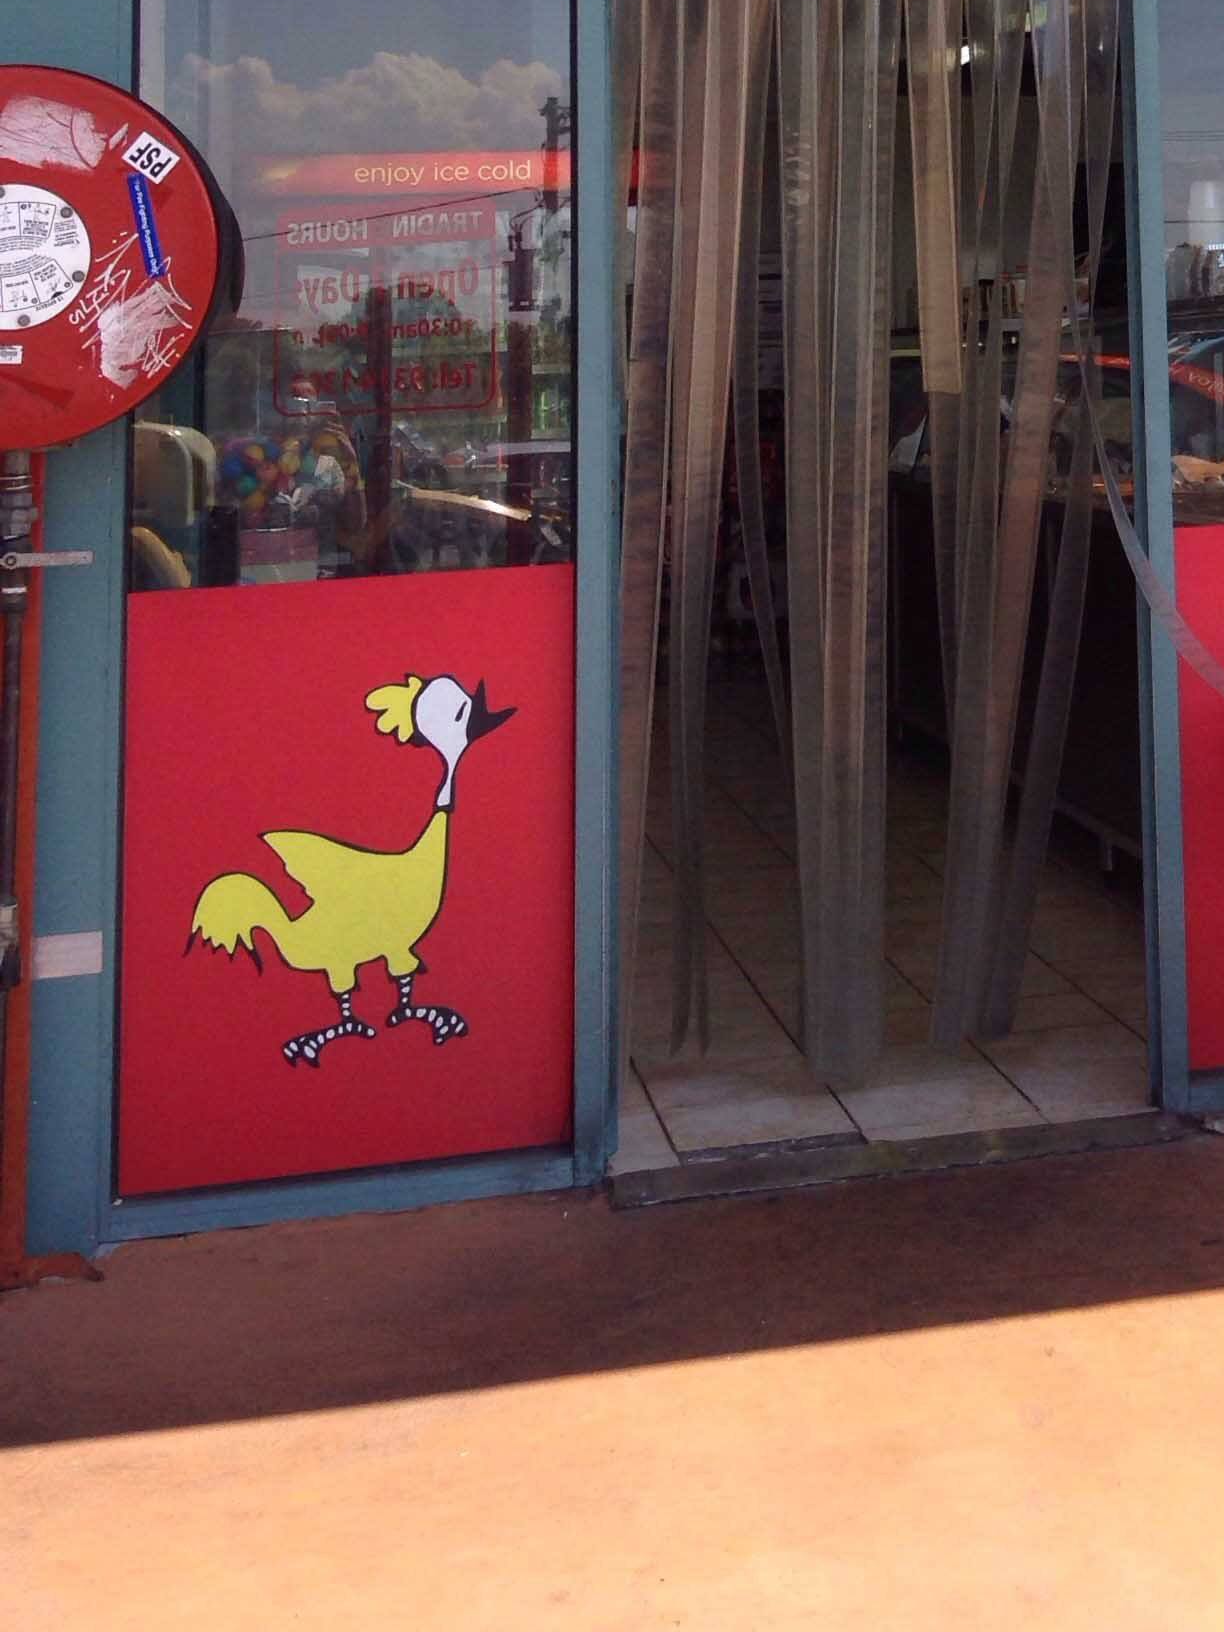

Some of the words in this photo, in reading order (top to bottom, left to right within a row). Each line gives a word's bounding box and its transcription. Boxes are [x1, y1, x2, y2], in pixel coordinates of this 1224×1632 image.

[128, 142, 172, 178] PSF
[354, 162, 425, 186] enjoy
[433, 162, 470, 182] ice
[477, 159, 532, 181] cold
